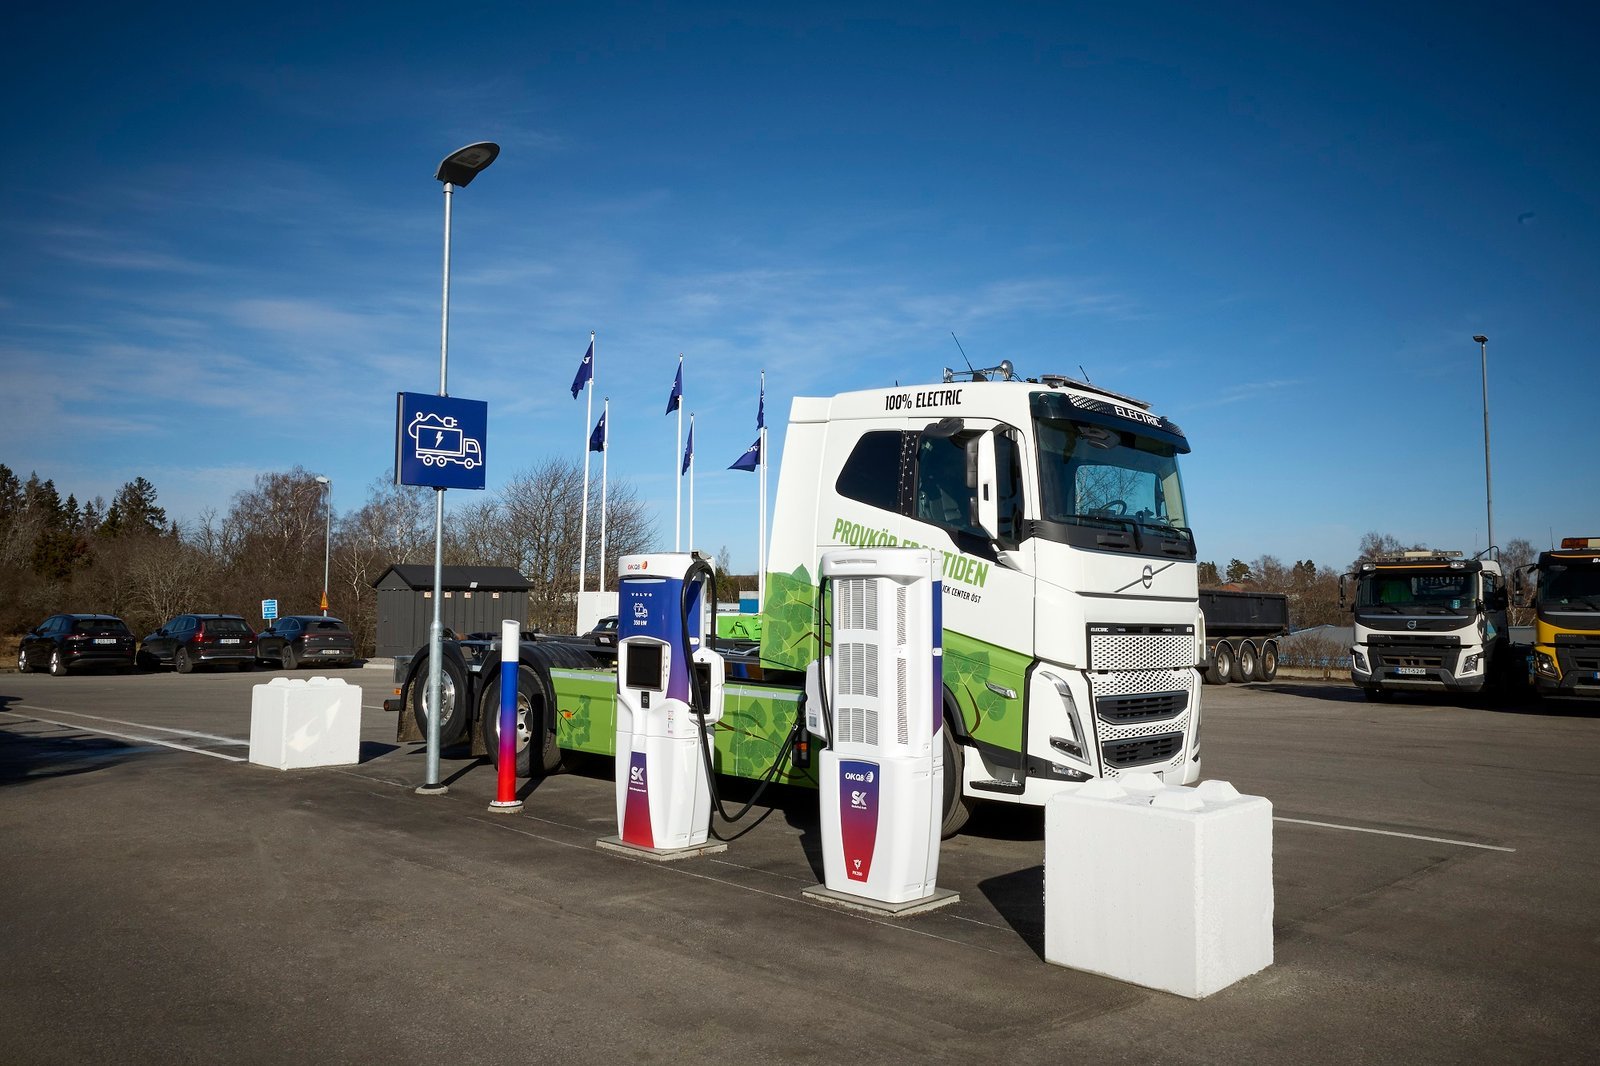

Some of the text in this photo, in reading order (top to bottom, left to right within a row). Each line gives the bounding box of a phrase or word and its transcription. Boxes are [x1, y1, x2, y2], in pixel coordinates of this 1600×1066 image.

[885, 389, 963, 411] 100% ELECTRIC
[1114, 405, 1163, 428] ELECTRIC
[951, 587, 971, 600] CENTER
[631, 766, 644, 781] SK
[845, 772, 864, 782] OKQ8
[851, 790, 867, 806] SK
